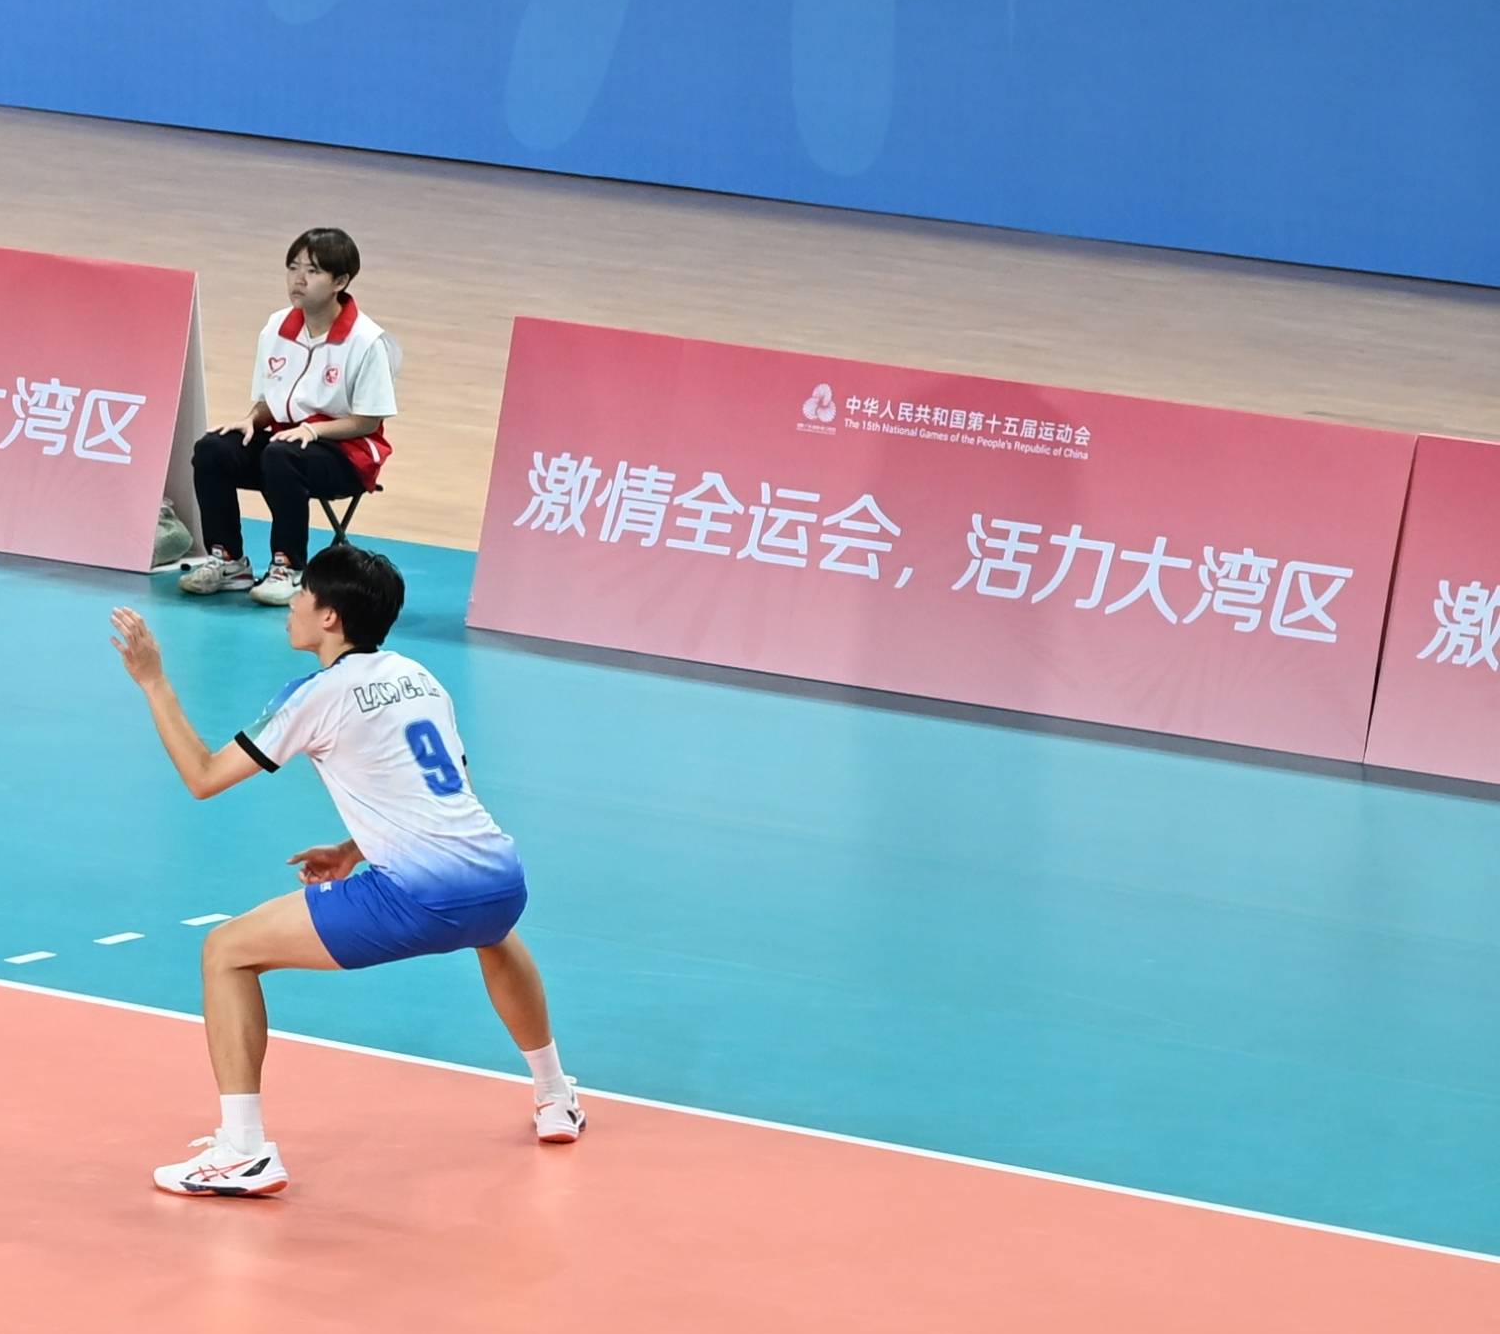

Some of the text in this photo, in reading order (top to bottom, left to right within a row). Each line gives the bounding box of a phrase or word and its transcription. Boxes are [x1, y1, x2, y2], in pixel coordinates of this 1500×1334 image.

[845, 418, 859, 429] The
[862, 420, 880, 432] 15th
[883, 424, 918, 437] National
[920, 428, 949, 441] Games
[951, 431, 960, 442] of
[961, 433, 975, 445] the
[977, 435, 1012, 450] People's
[1014, 441, 1051, 455] Republic
[1053, 444, 1062, 456] of
[1064, 447, 1088, 459] China
[846, 395, 1091, 447] 中华人民共和国第十五届运动会
[354, 683, 400, 713] LAM
[398, 676, 424, 699] C.
[405, 718, 462, 797] 9
